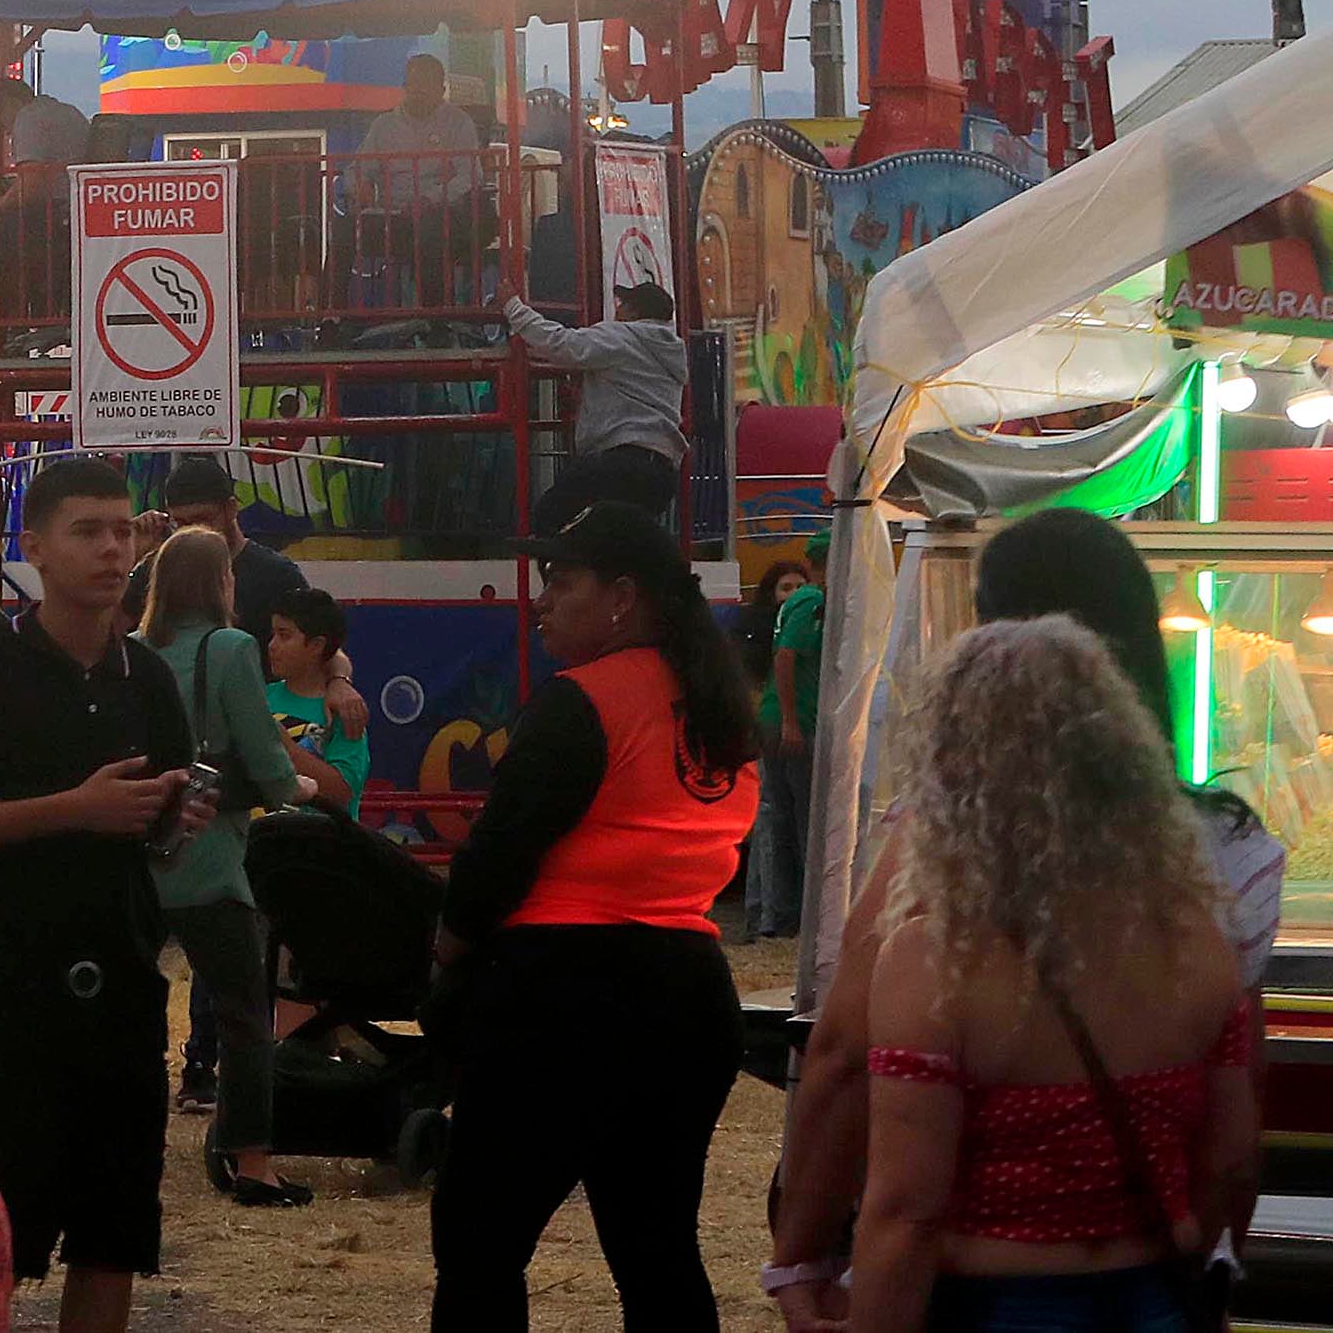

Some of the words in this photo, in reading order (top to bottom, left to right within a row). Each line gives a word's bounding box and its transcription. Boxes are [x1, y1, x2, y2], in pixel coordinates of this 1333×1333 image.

[88, 181, 220, 204] PROHIBIDO
[113, 208, 195, 229] FUMAR
[89, 390, 157, 403] AMBIENTE
[161, 389, 200, 402] LIBRE
[203, 389, 222, 401] DE
[96, 406, 136, 418] HUMO
[140, 406, 158, 417] DE
[161, 405, 216, 417] TABACO
[135, 430, 152, 439] LEY
